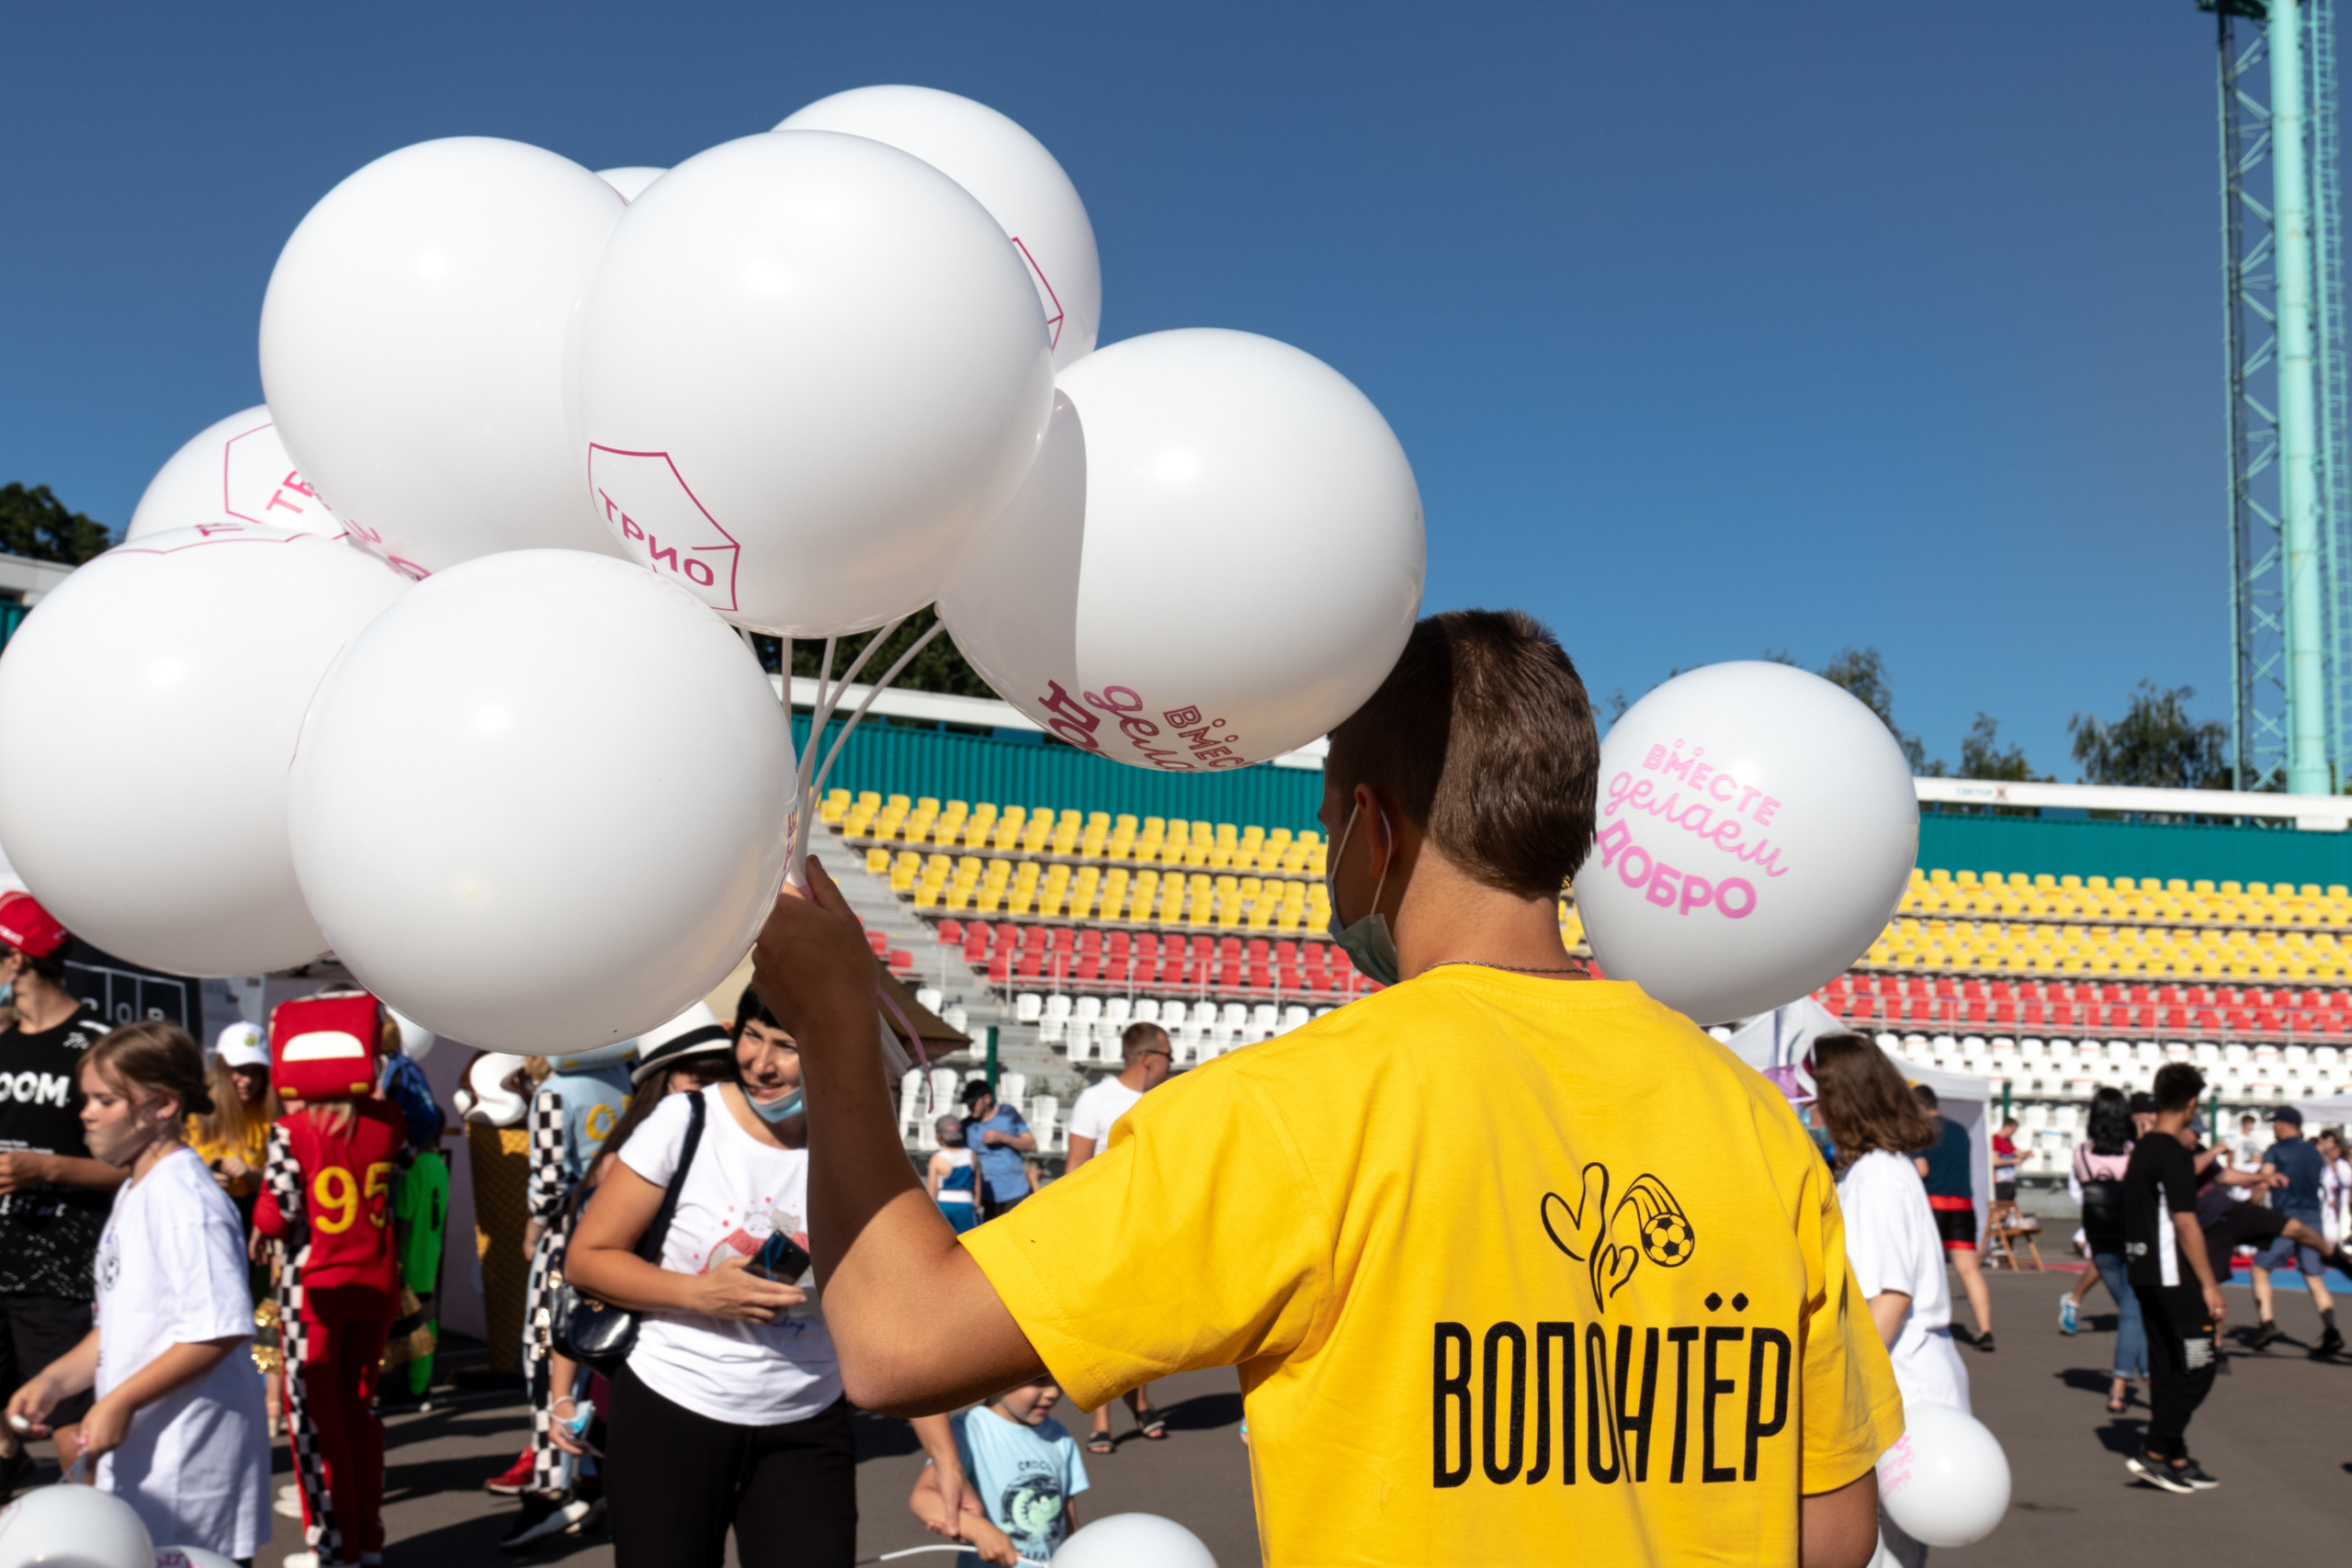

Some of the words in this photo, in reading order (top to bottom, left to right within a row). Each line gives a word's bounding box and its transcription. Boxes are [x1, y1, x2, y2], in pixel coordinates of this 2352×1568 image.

[598, 487, 714, 587] ТРИО
[1083, 685, 1196, 771] дела
[1162, 705, 1259, 770] ВМЕС
[1604, 772, 1790, 878] делаем
[1642, 739, 1781, 828] ВМЕСТЕ
[1597, 818, 1757, 920] ДОБРО
[1432, 1292, 1792, 1489] ВОЛОНТЁР
